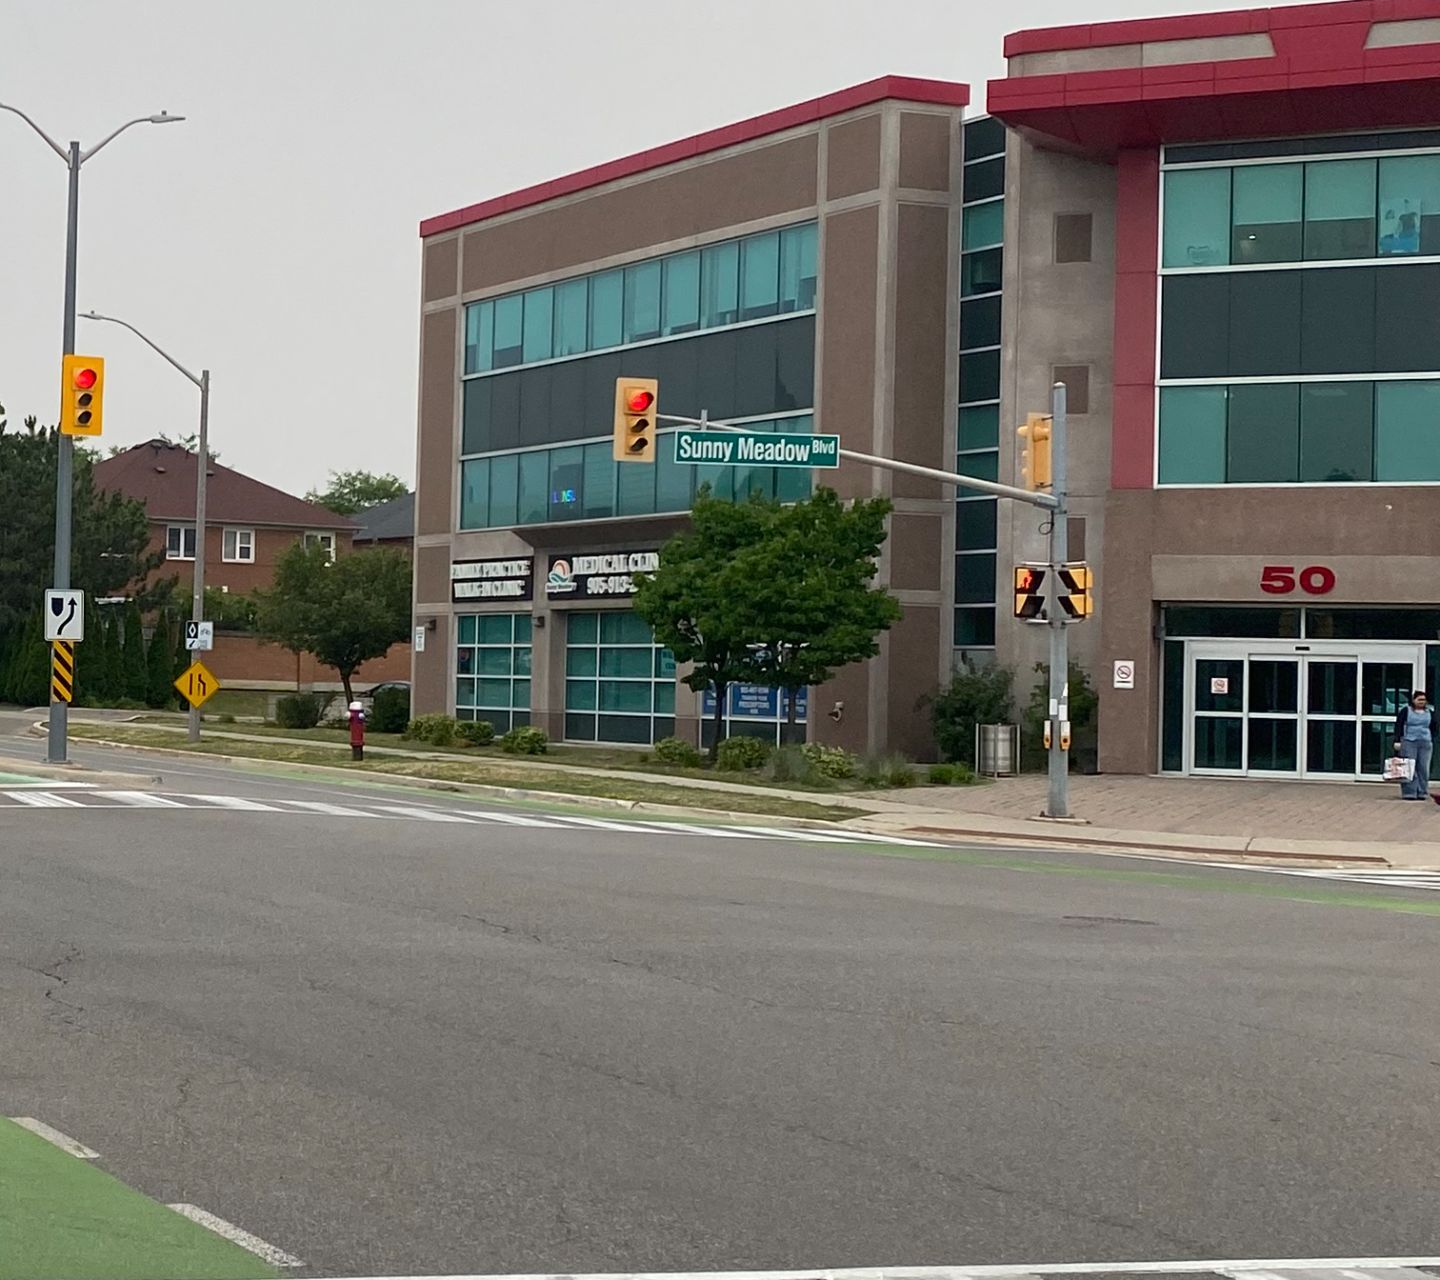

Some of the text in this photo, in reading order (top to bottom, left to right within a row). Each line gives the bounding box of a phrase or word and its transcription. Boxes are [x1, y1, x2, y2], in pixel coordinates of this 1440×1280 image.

[679, 434, 835, 462] Sunny Meadow Blvd
[572, 551, 659, 576] MEDICAL CLIN
[1260, 565, 1336, 595] 50
